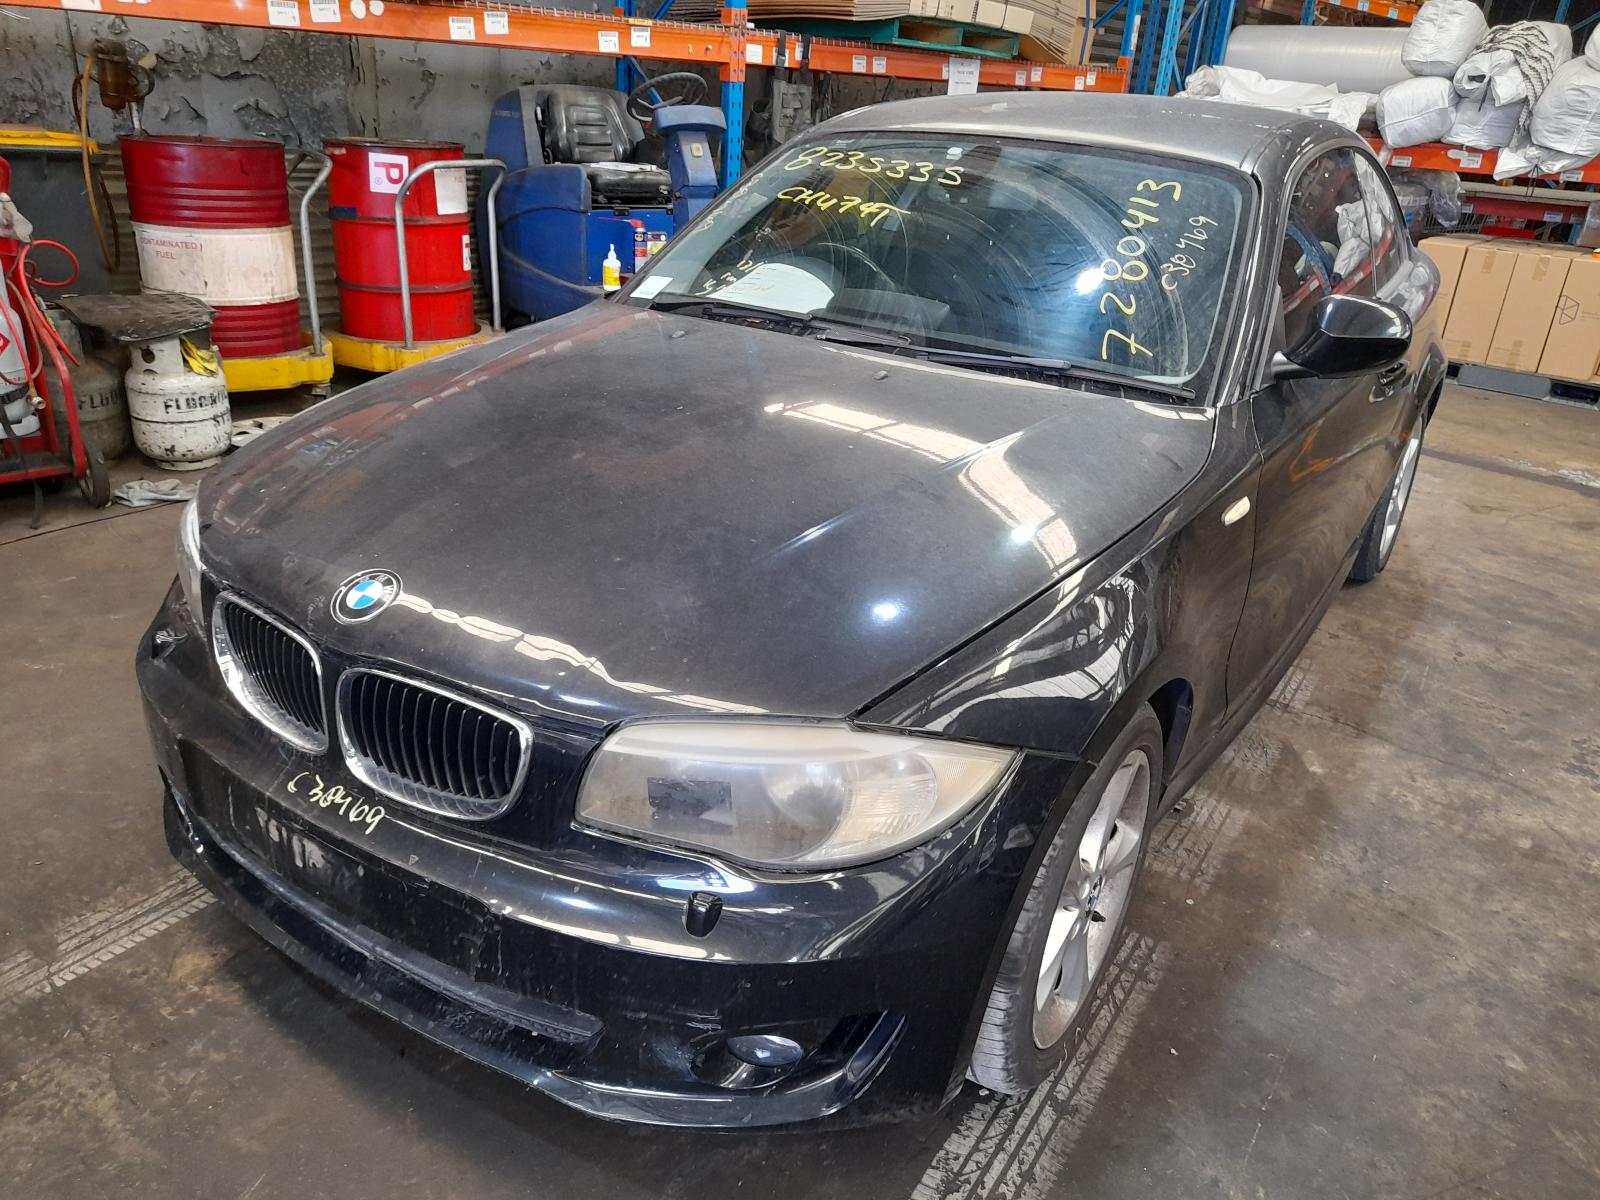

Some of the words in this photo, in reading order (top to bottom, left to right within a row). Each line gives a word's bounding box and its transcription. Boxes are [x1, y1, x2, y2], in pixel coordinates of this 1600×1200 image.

[155, 250, 176, 259] FUEL
[1100, 179, 1182, 360] 7280413
[287, 772, 385, 835] C38469
